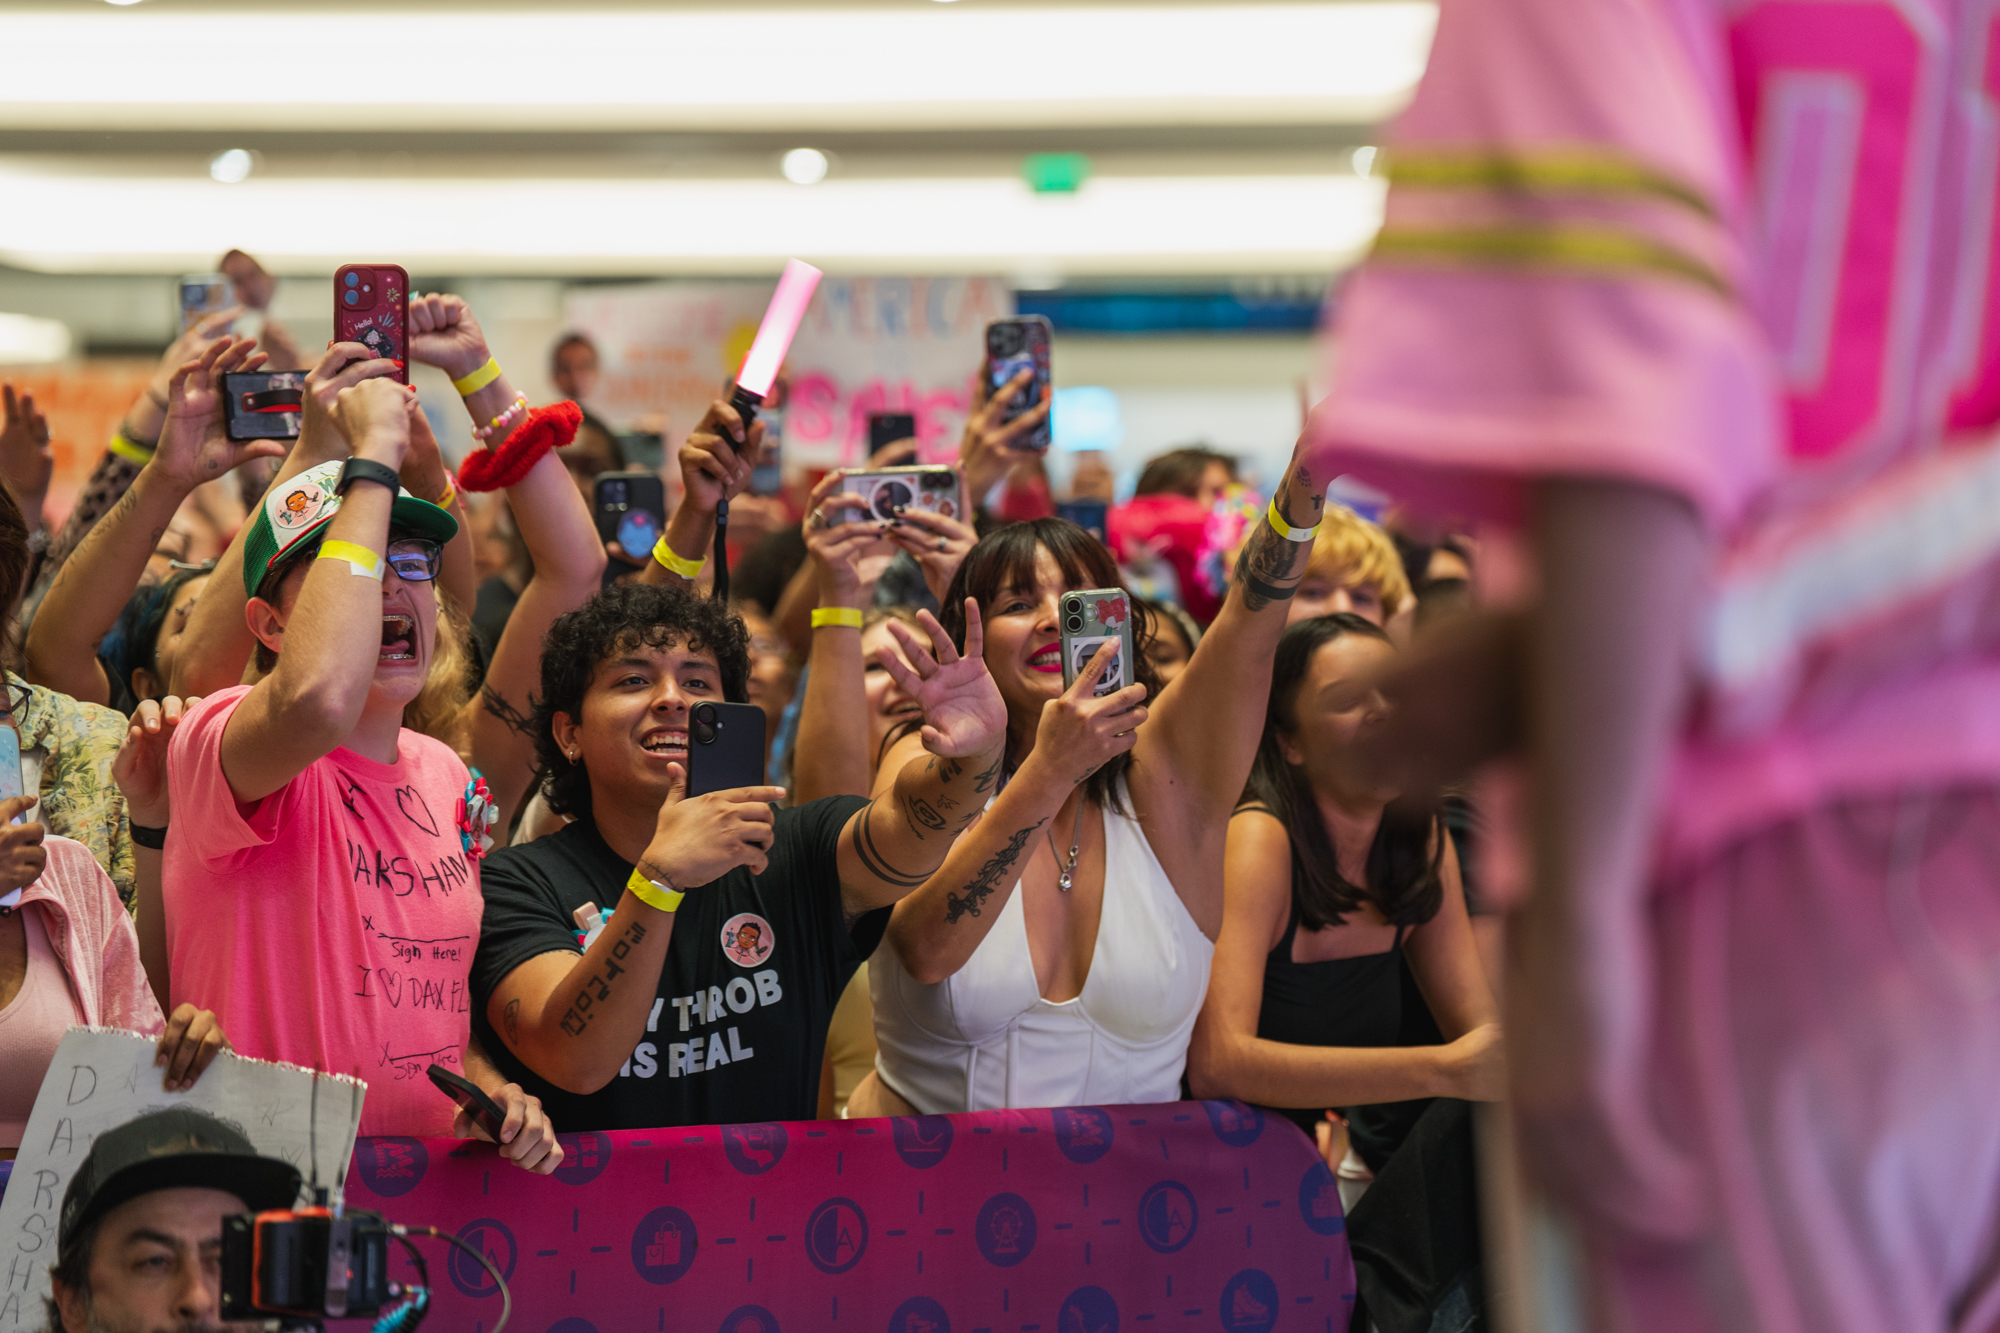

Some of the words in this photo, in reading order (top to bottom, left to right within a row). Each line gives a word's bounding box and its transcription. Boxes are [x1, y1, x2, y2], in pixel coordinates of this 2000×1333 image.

[354, 317, 373, 330] Hello!
[391, 941, 422, 963] Sign
[433, 946, 461, 961] Here!
[354, 964, 376, 997] I
[408, 977, 446, 1011] DAX
[451, 978, 470, 1013] FL
[672, 968, 783, 1032] THROB
[669, 1026, 754, 1078] REAL
